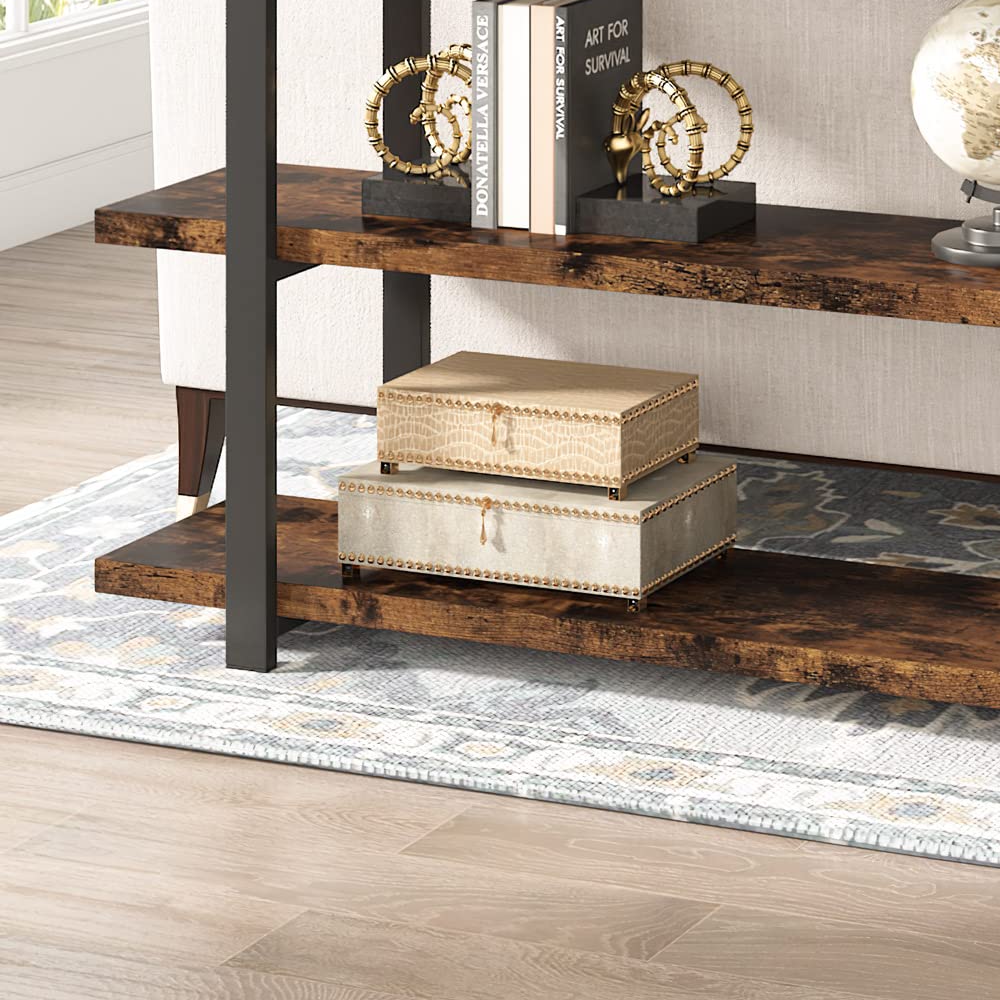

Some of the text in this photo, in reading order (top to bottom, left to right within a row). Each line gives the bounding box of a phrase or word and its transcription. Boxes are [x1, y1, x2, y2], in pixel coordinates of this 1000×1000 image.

[584, 19, 629, 48] ART FOR
[585, 46, 631, 76] SURVIVAL
[476, 15, 489, 217] DONATELLA VERSACE
[555, 15, 566, 141] ART FOR SURVIVAL
